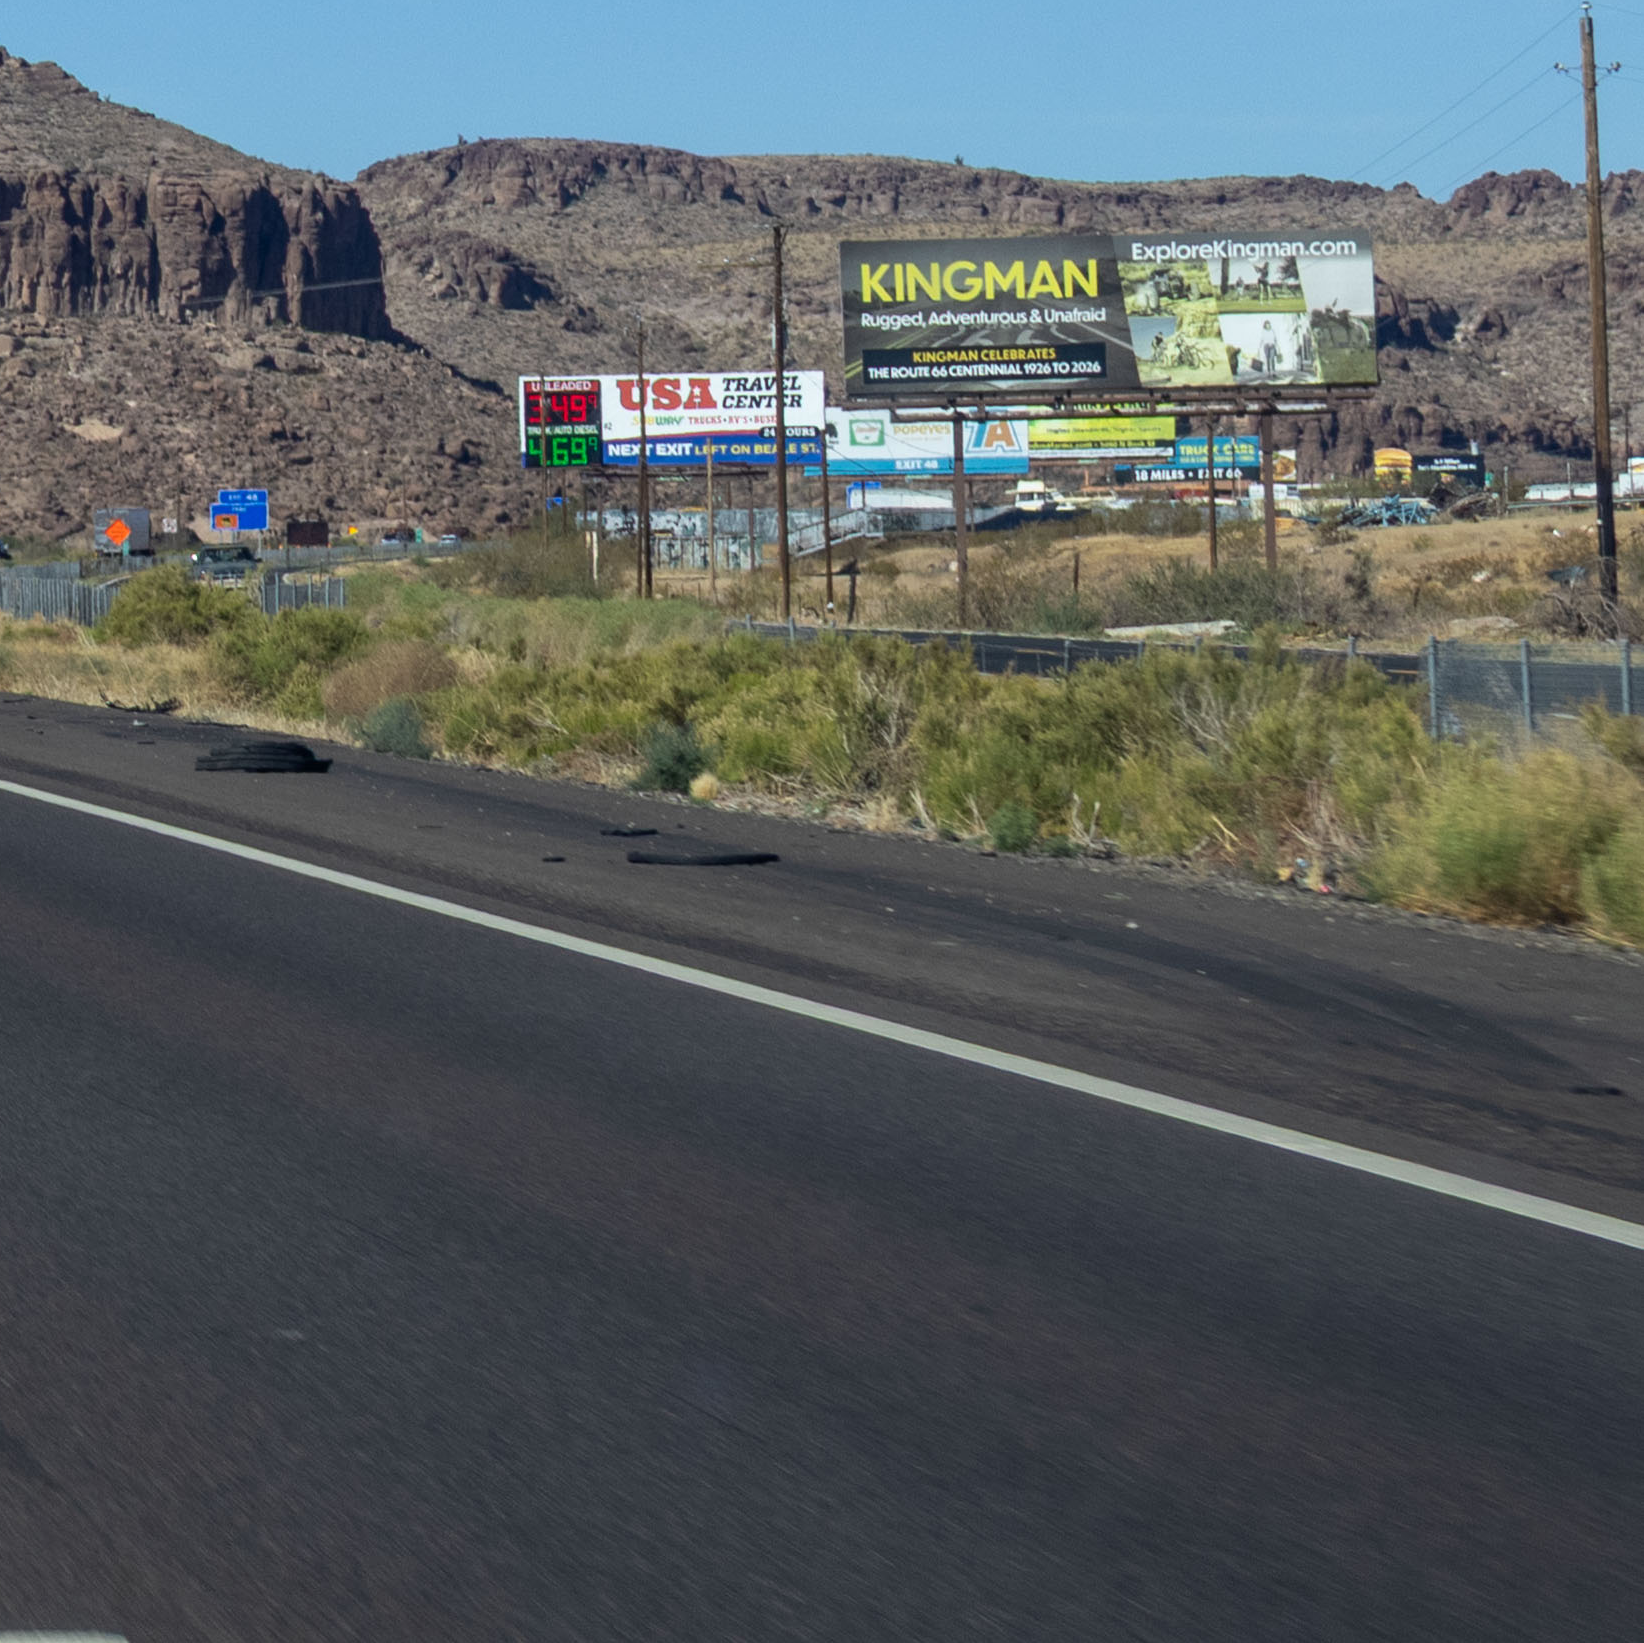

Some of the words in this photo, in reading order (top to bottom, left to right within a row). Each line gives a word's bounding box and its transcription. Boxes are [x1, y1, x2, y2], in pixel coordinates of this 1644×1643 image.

[1131, 240, 1356, 262] ExploreKingman.com
[861, 259, 1098, 302] KINGMAN
[861, 311, 927, 330] Rugged,
[928, 309, 1027, 327] Adventurous
[1029, 309, 1042, 324] &
[1044, 307, 1106, 323] Unafraid
[913, 351, 978, 363] KINGMAN
[980, 348, 1056, 361] CELEBRATES
[868, 367, 890, 379] THE
[891, 365, 930, 378] ROUTE
[932, 364, 948, 377] 66
[949, 363, 1023, 376] CENTENNIAL
[1024, 362, 1051, 374] 1926
[1052, 362, 1070, 373] TO
[1071, 360, 1101, 373] 2026
[616, 378, 717, 410] USA
[632, 416, 684, 426] SBWAY
[688, 415, 722, 425] TRUCKS
[527, 425, 552, 435] TRUK
[553, 425, 573, 435] AUTO
[574, 424, 599, 435] DIESEL
[763, 426, 777, 437] 24
[965, 420, 1022, 453] TA
[608, 443, 654, 457] NEXT
[656, 443, 693, 456] EXIT
[695, 445, 727, 455] LEFT
[731, 444, 751, 454] ON
[754, 444, 798, 454] BEAE
[801, 443, 820, 454] ST.
[895, 460, 922, 470] EXIT
[1135, 470, 1148, 481] 18
[1150, 470, 1185, 481] MILES
[1198, 468, 1224, 479] EXIT
